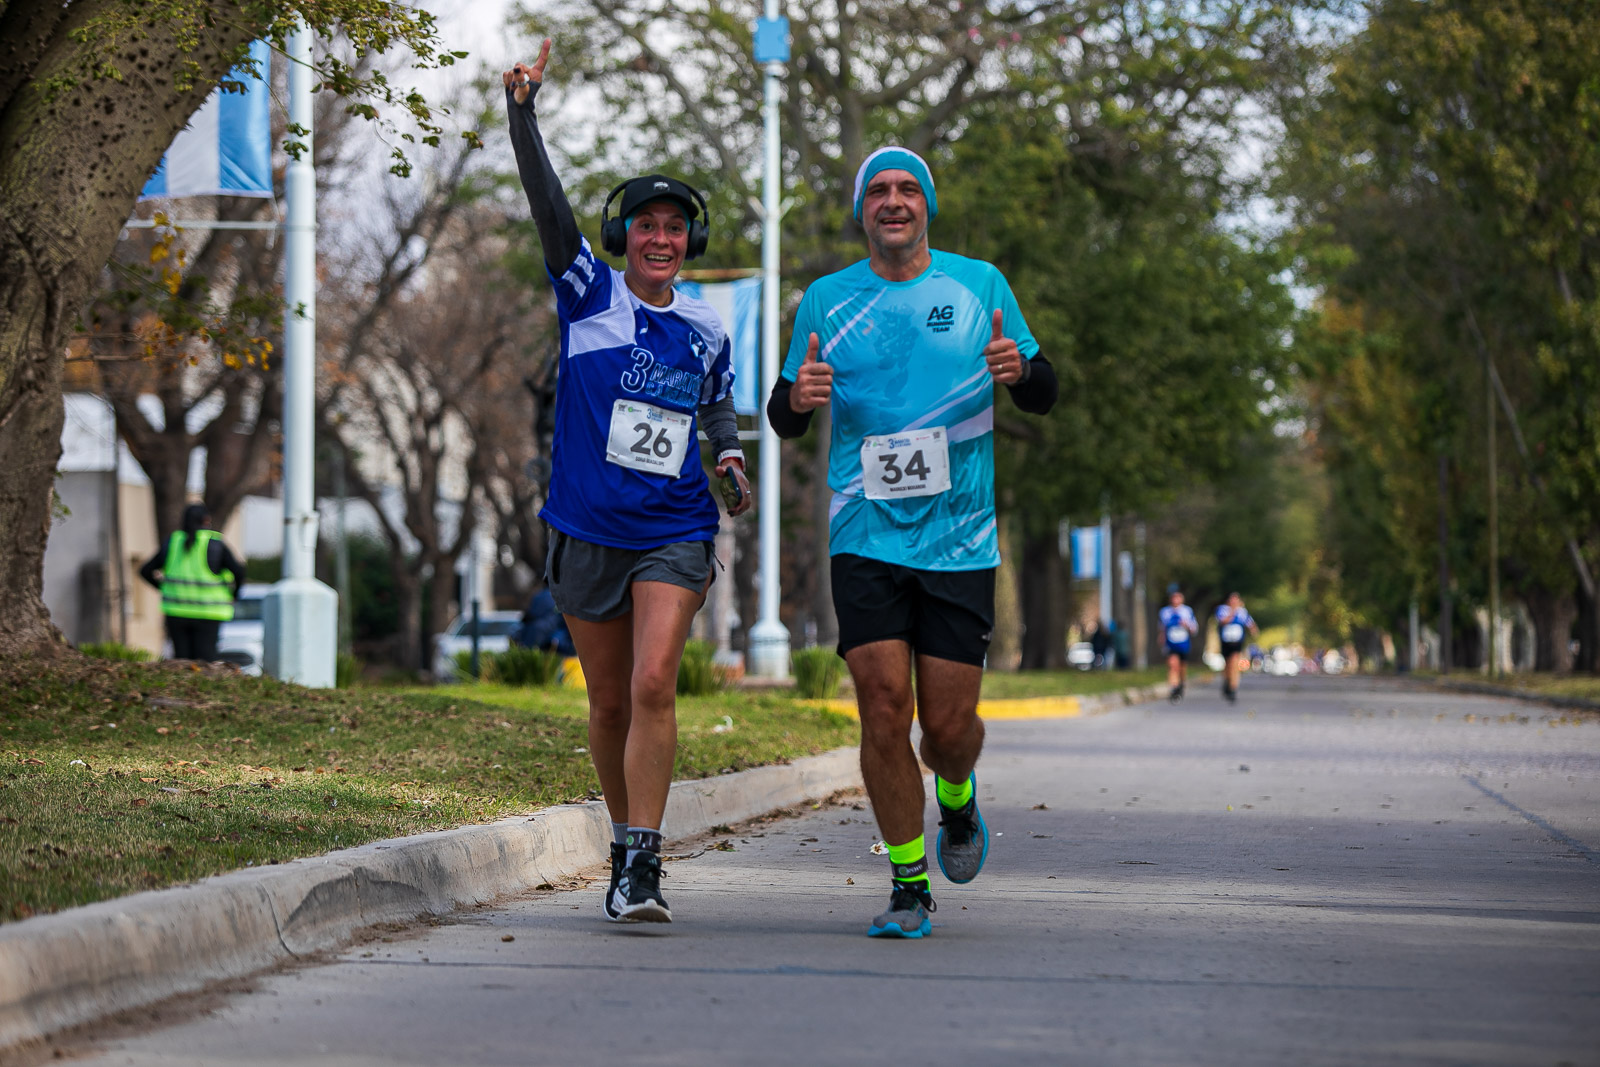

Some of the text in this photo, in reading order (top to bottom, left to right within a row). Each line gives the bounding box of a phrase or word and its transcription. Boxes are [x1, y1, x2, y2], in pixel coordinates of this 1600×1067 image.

[927, 305, 954, 321] AG
[621, 347, 654, 393] 3
[630, 422, 672, 458] 26
[878, 449, 931, 484] 34
